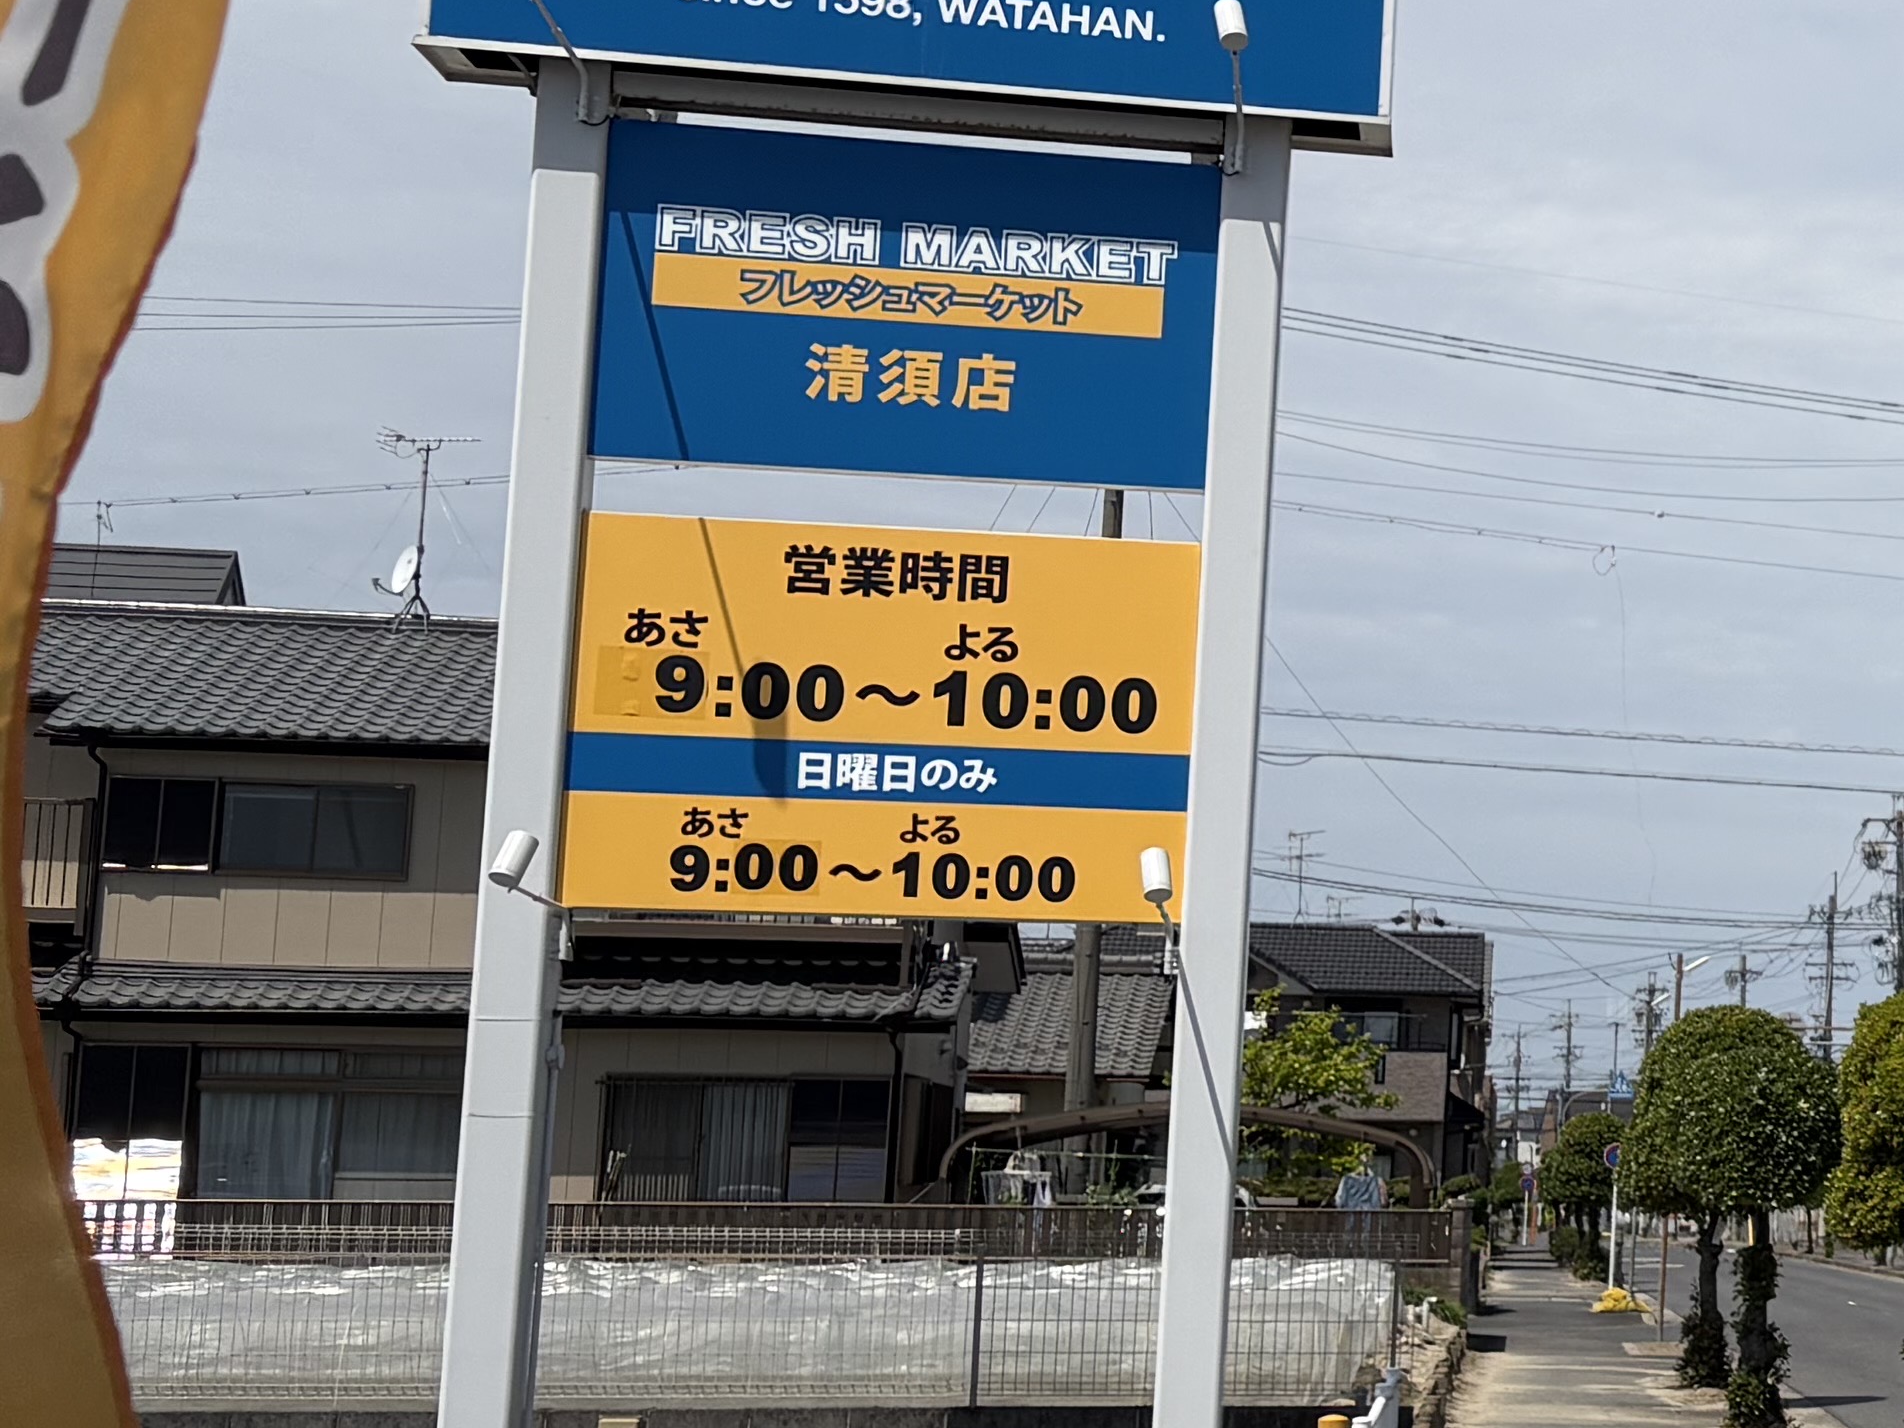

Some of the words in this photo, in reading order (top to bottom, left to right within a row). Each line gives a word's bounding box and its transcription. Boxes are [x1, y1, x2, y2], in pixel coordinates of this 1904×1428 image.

[655, 203, 881, 264] FRESH
[899, 222, 1178, 285] MARKET
[741, 269, 1082, 325] フレッシュマーケット
[805, 342, 1016, 412] 清須店
[784, 544, 1010, 604] 営業時間
[624, 607, 709, 649] あさ
[944, 623, 1019, 663] よる
[797, 752, 998, 793] 日曜日のみ
[680, 806, 749, 839] あさ
[899, 813, 961, 845] よる
